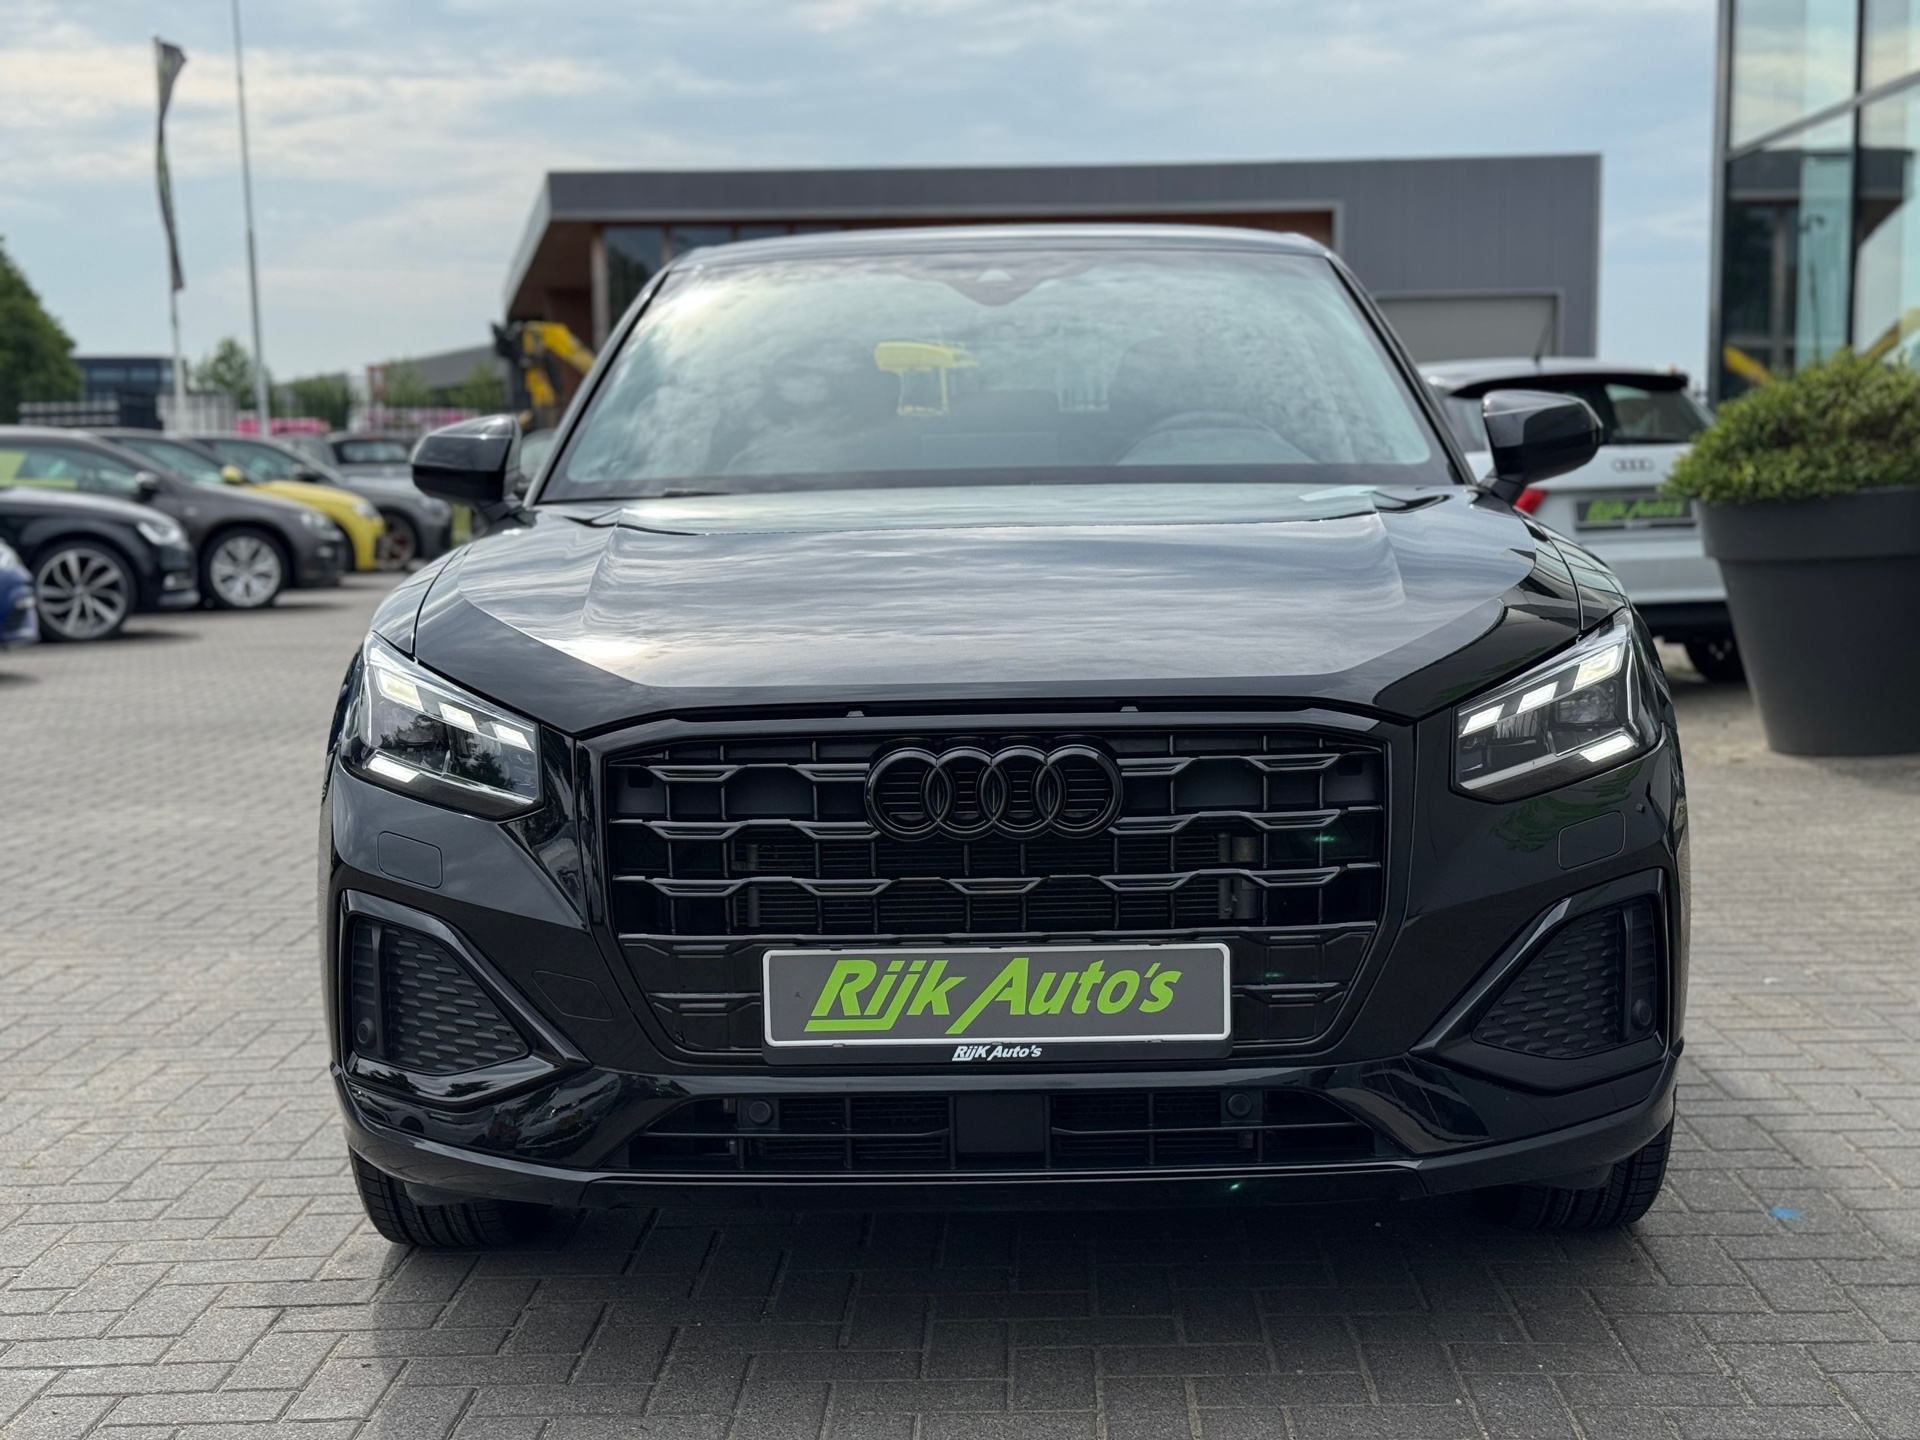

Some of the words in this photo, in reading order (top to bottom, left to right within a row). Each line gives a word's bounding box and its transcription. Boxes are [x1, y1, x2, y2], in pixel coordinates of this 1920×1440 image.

[804, 959, 966, 1032] Rijk
[946, 957, 1182, 1035] Auto's
[986, 1044, 1043, 1061] Auto's
